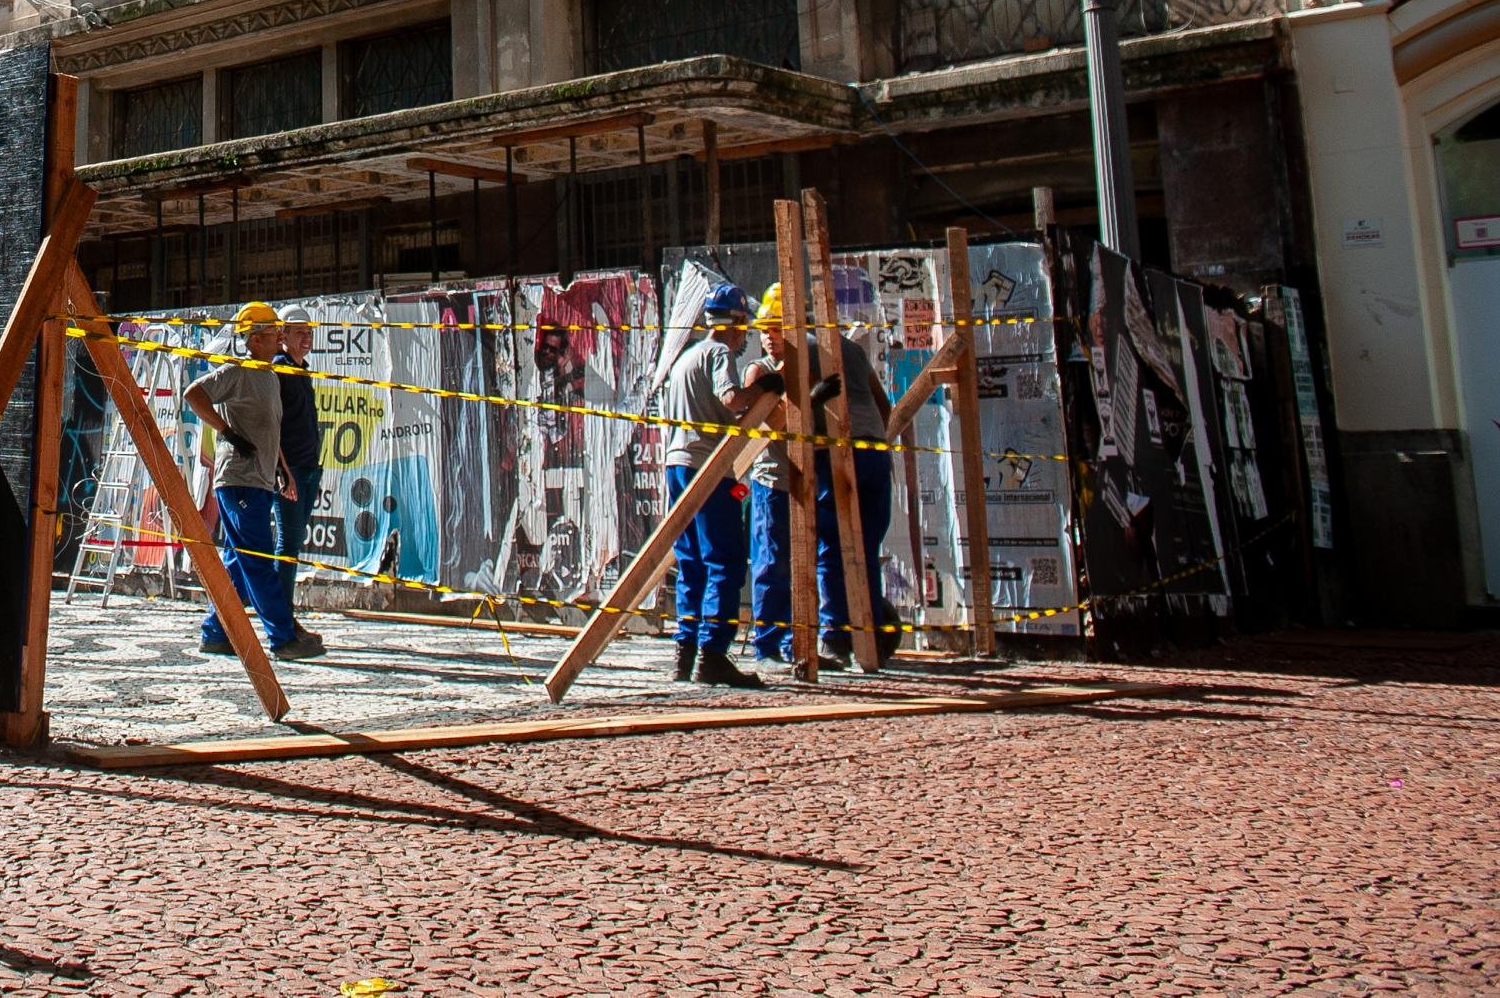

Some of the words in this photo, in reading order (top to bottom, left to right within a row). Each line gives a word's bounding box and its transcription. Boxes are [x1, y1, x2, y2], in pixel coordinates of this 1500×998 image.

[335, 357, 372, 366] ELETRO
[315, 393, 367, 415] ULAR
[370, 407, 384, 418] no
[380, 423, 432, 440] ANDROID
[633, 443, 653, 465] 24
